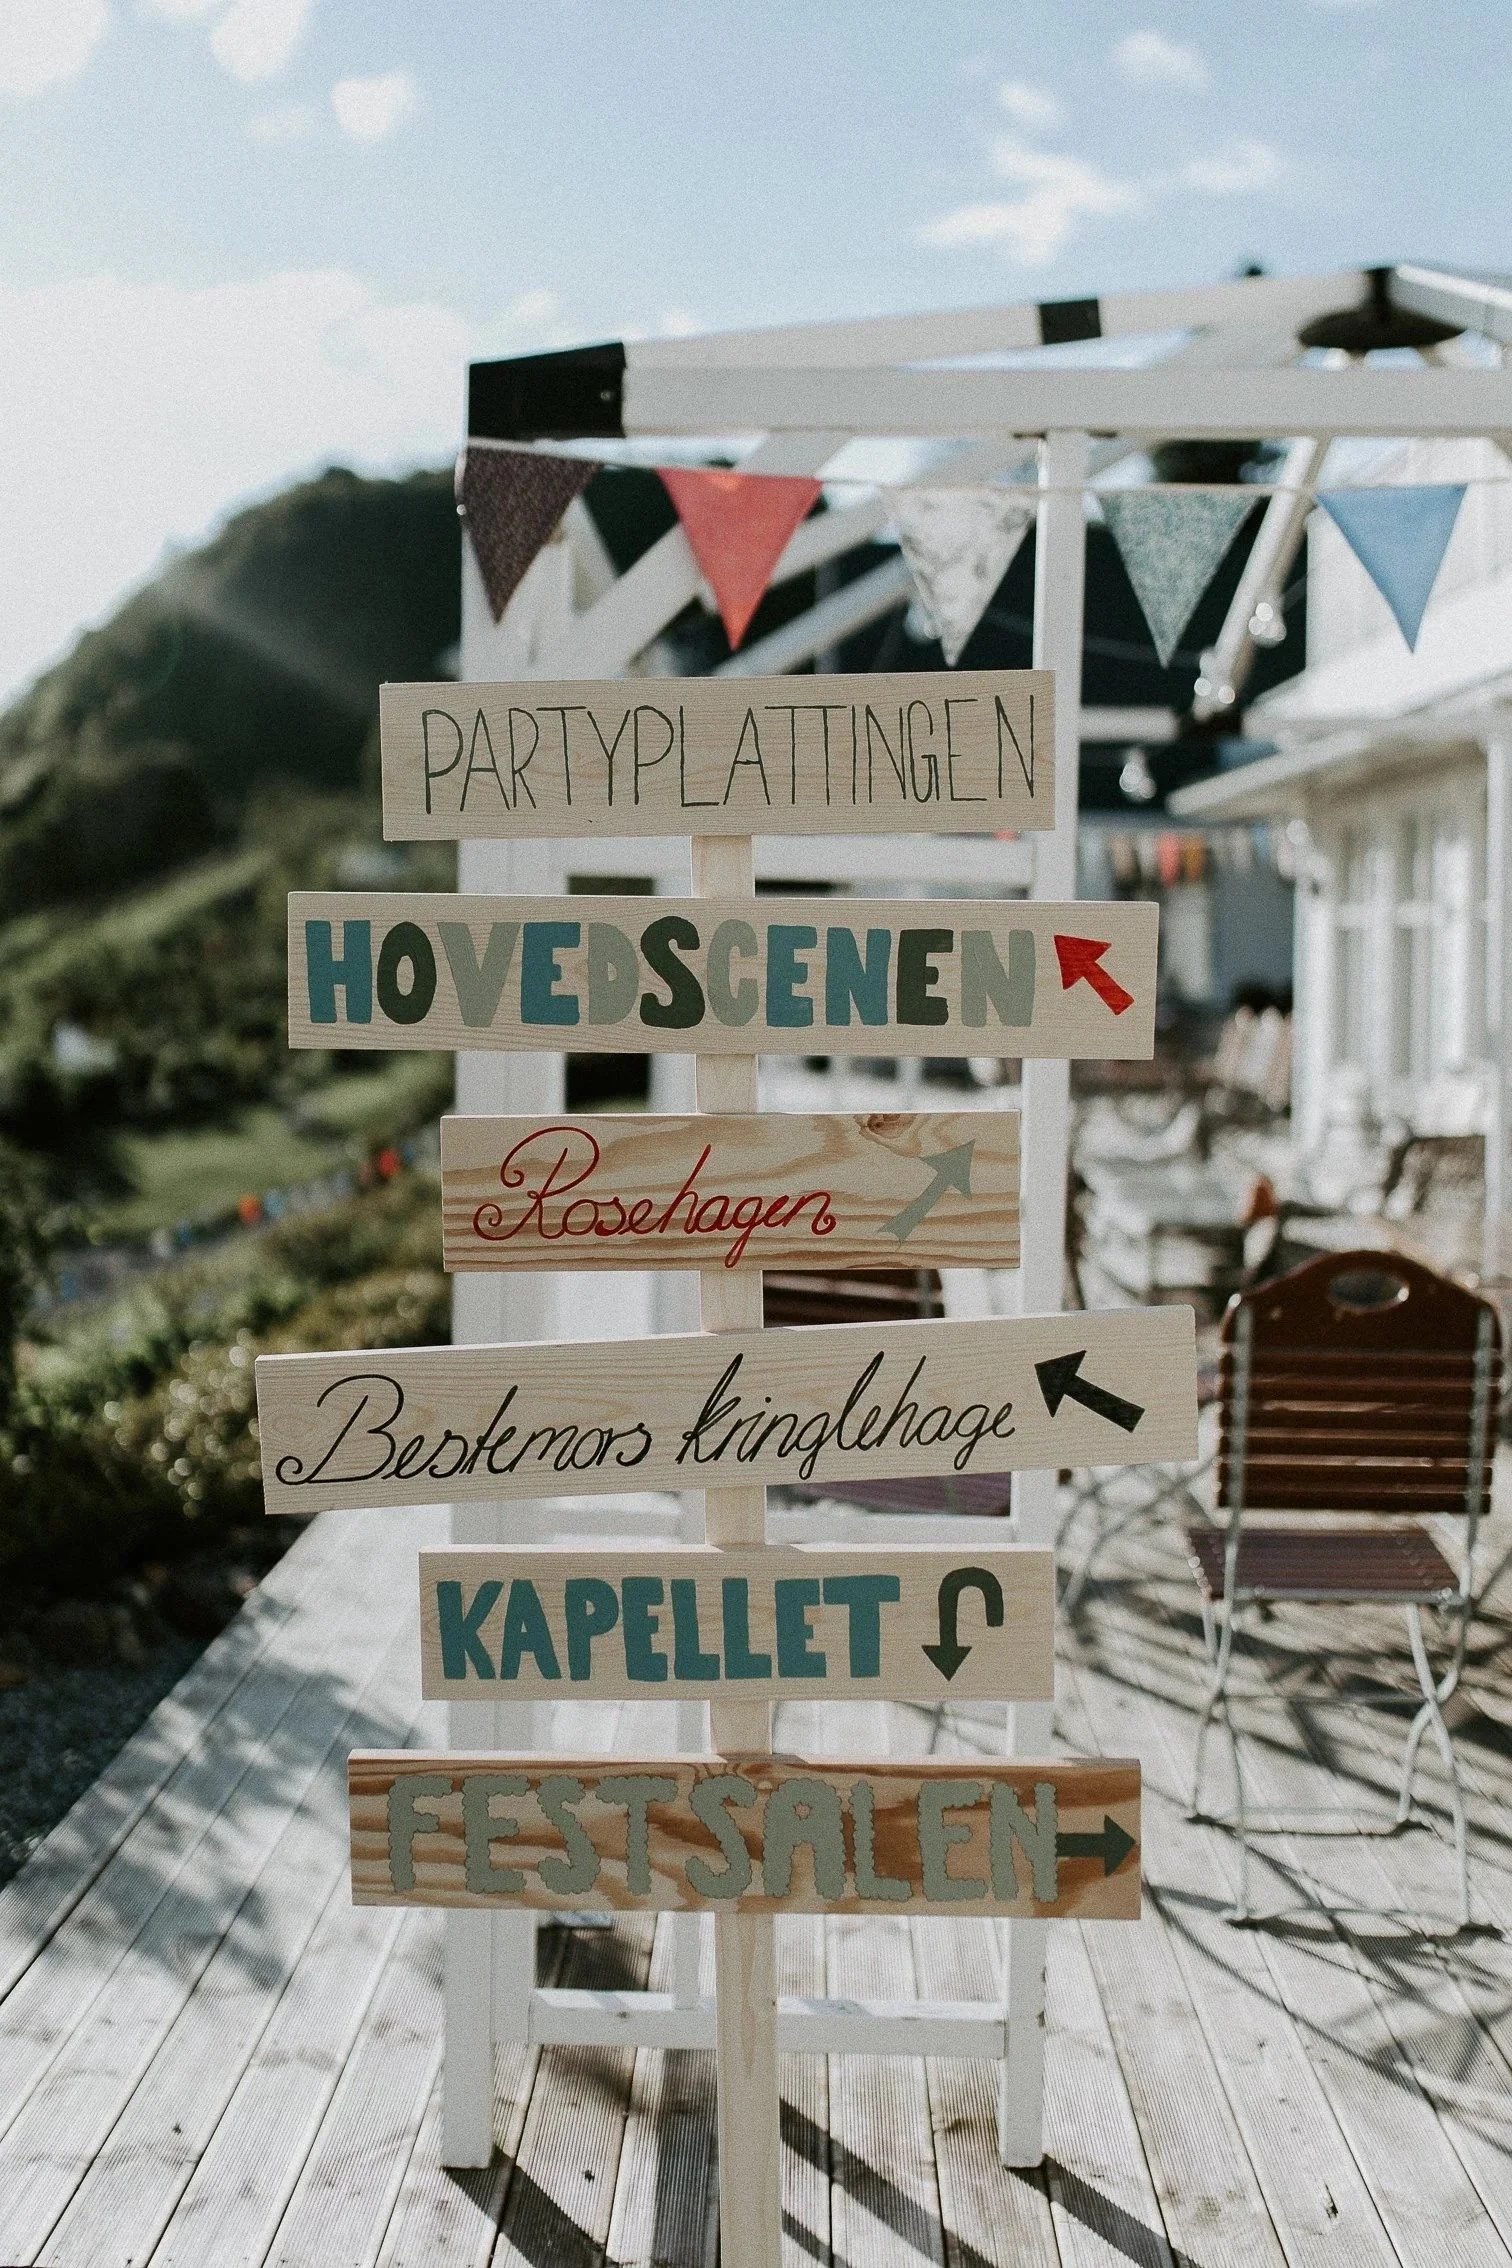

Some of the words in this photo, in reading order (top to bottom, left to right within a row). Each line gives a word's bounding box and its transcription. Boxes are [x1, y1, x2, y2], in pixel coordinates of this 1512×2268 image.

[421, 694, 1036, 815] PARTYPLATTINGEN
[304, 914, 1037, 1030] HOVEDSCENEN
[472, 1126, 837, 1269] Rosehagen
[275, 1373, 653, 1485] Bestemors
[675, 1352, 1016, 1480] kringlehage
[435, 1573, 901, 1684] KAPELLET
[385, 1772, 1060, 1905] FESTSALEN
